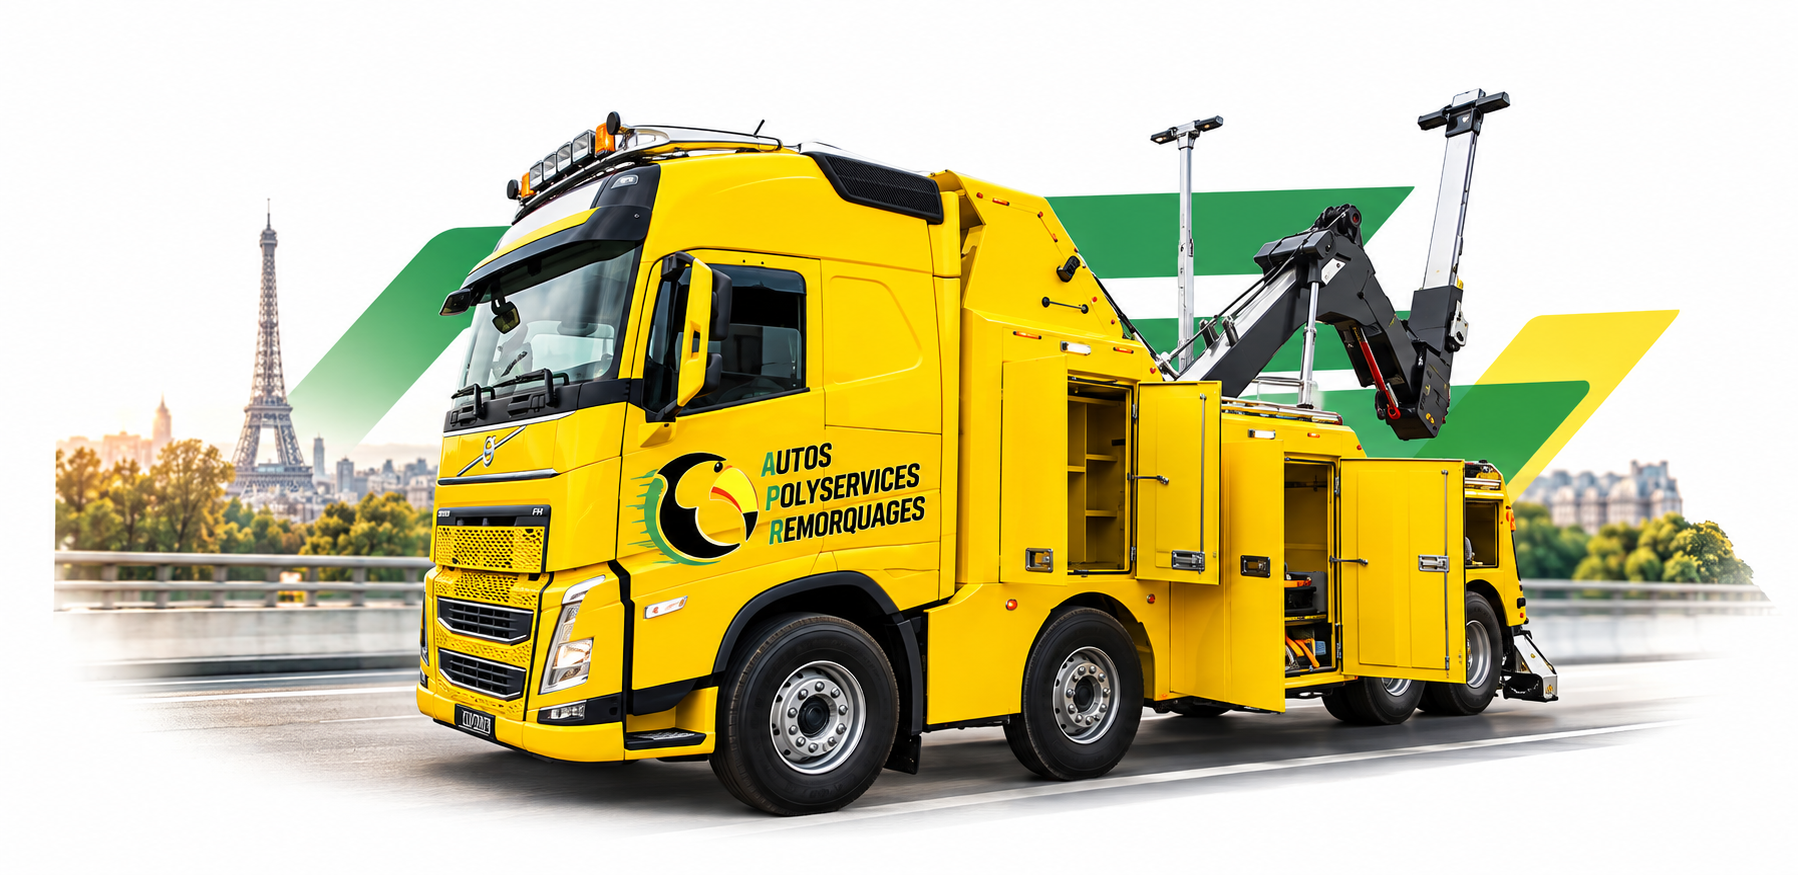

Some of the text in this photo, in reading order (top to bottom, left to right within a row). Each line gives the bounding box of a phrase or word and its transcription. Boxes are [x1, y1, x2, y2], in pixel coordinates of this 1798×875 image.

[761, 442, 832, 477] AUTOS
[765, 463, 921, 511] POLYSERVICES
[532, 507, 544, 516] FH
[769, 496, 926, 545] REMORQUAGES
